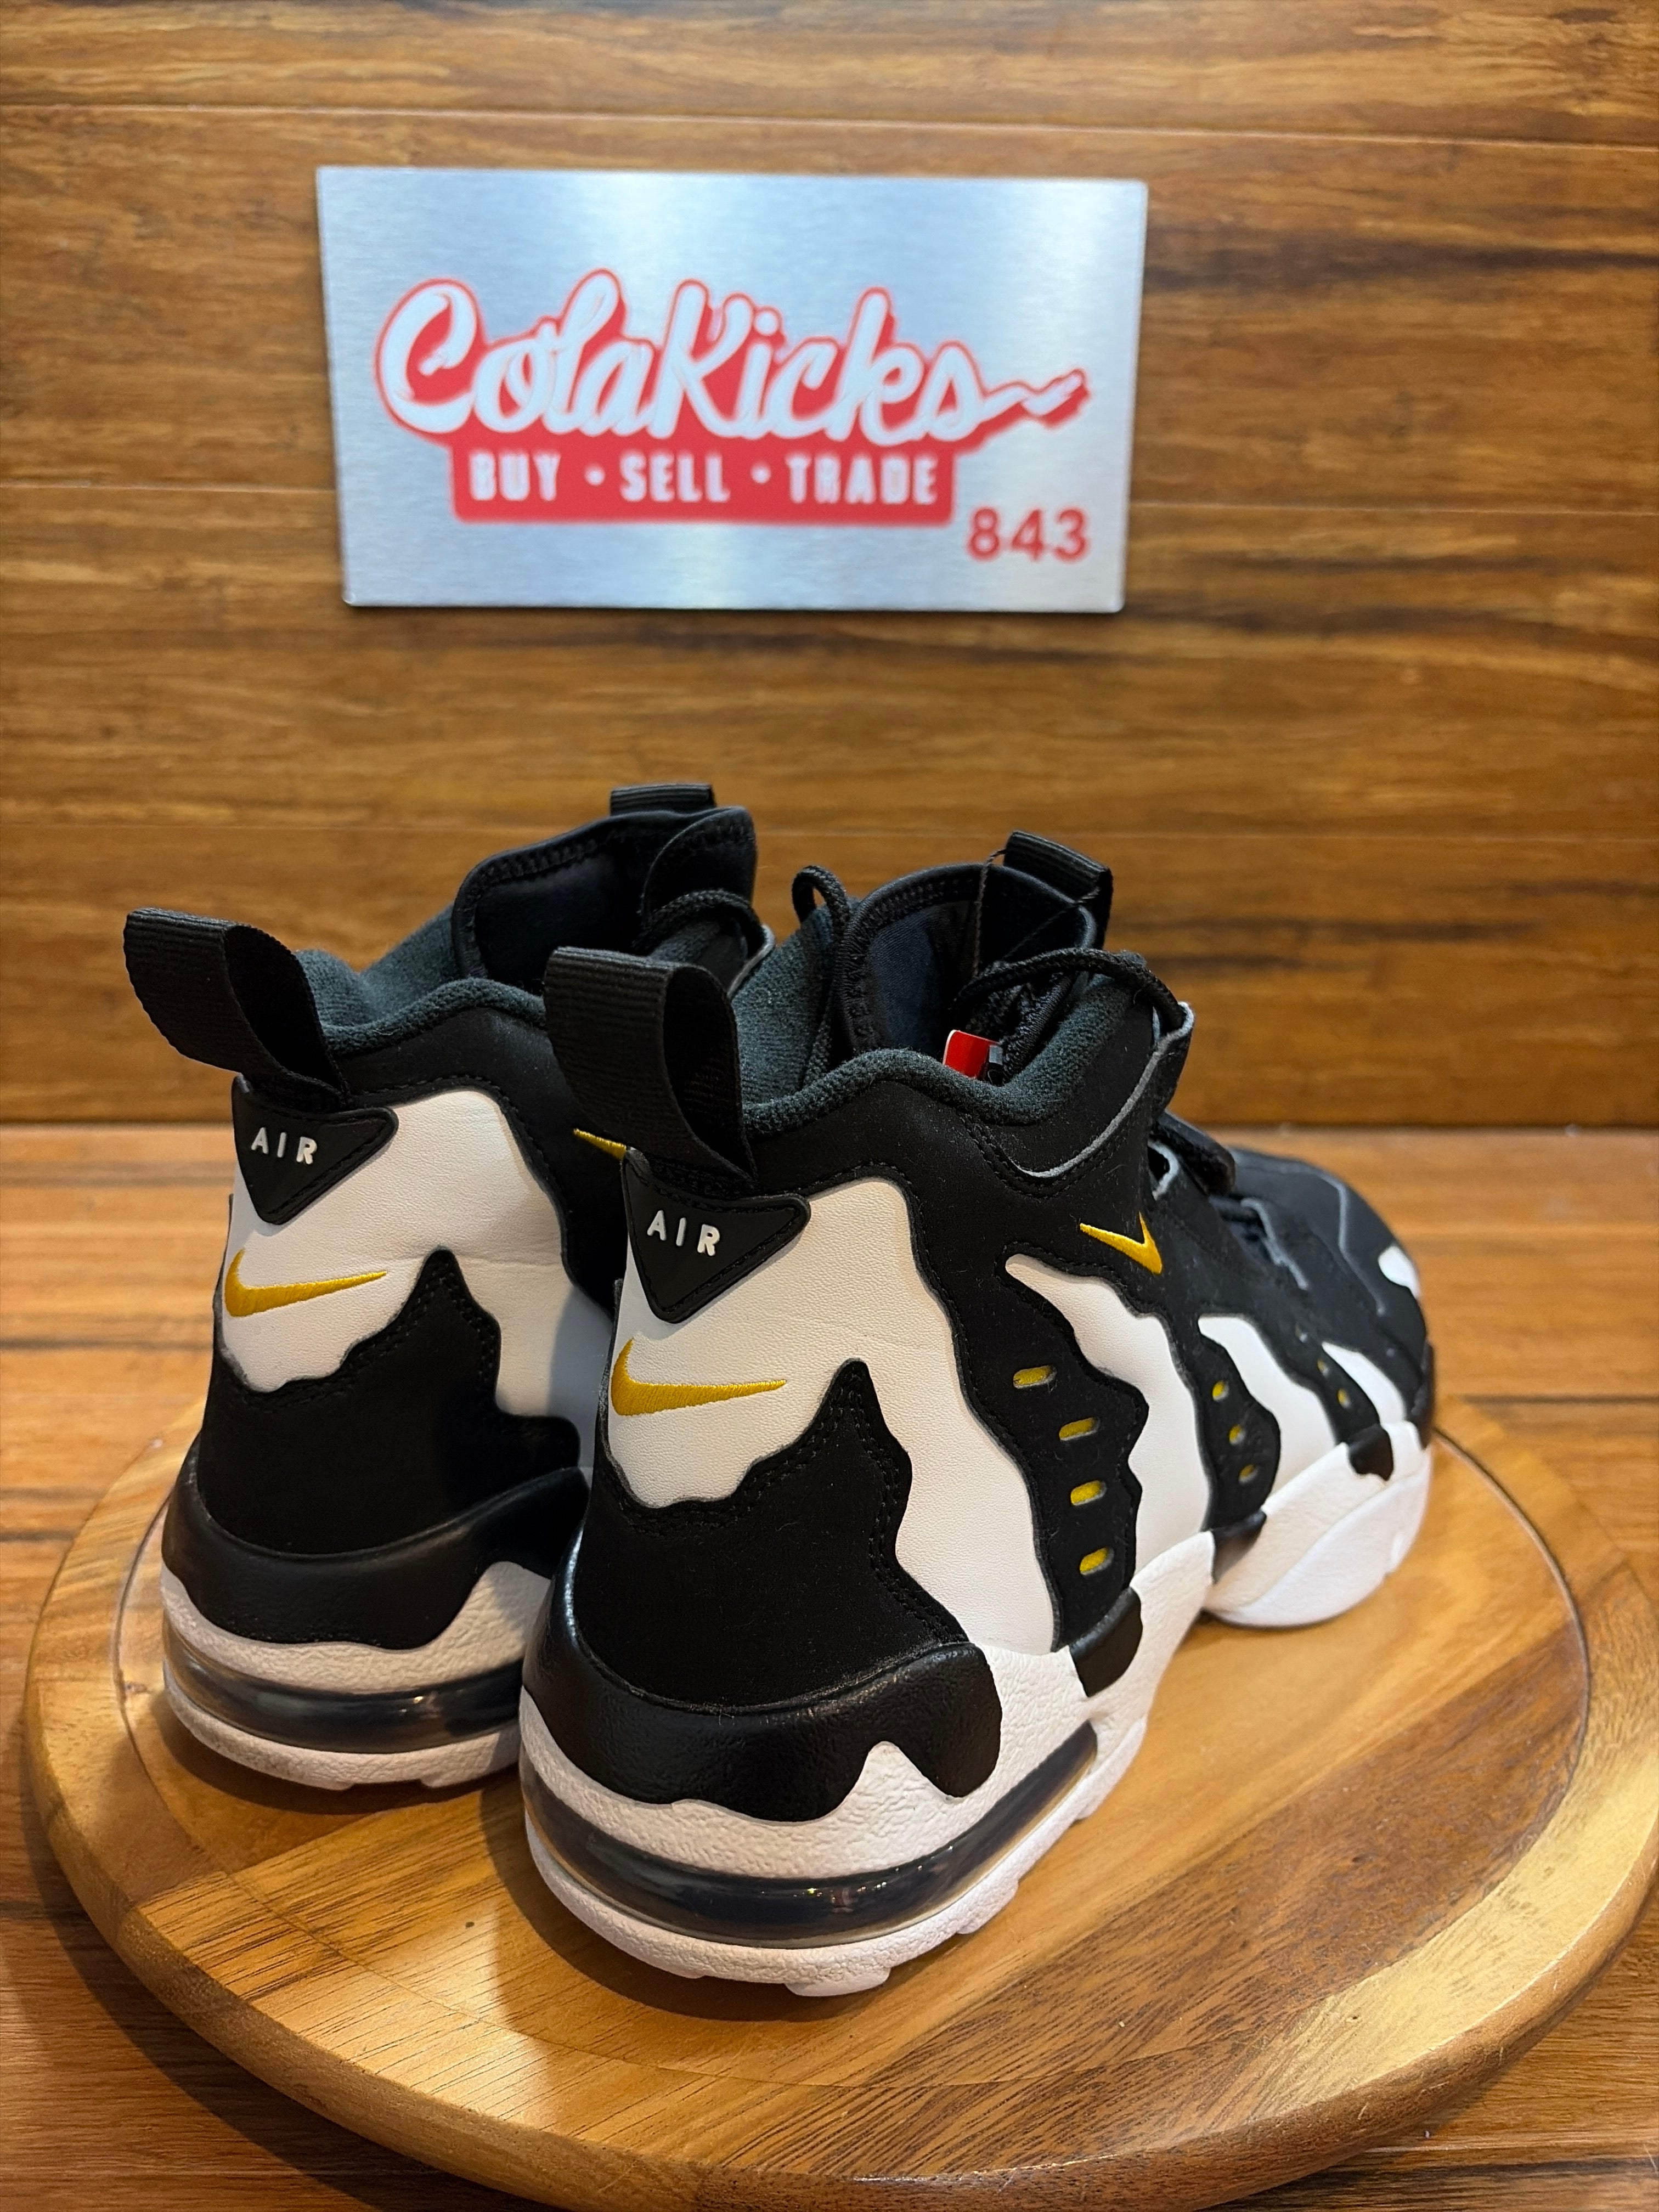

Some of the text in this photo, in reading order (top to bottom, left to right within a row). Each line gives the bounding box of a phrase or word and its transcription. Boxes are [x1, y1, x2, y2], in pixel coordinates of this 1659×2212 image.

[376, 269, 1090, 446] ColaKicks
[469, 451, 938, 506] BUY SELL TRADE
[966, 507, 1089, 562] 843
[251, 1126, 319, 1166] AIR
[647, 1209, 720, 1257] AIR
